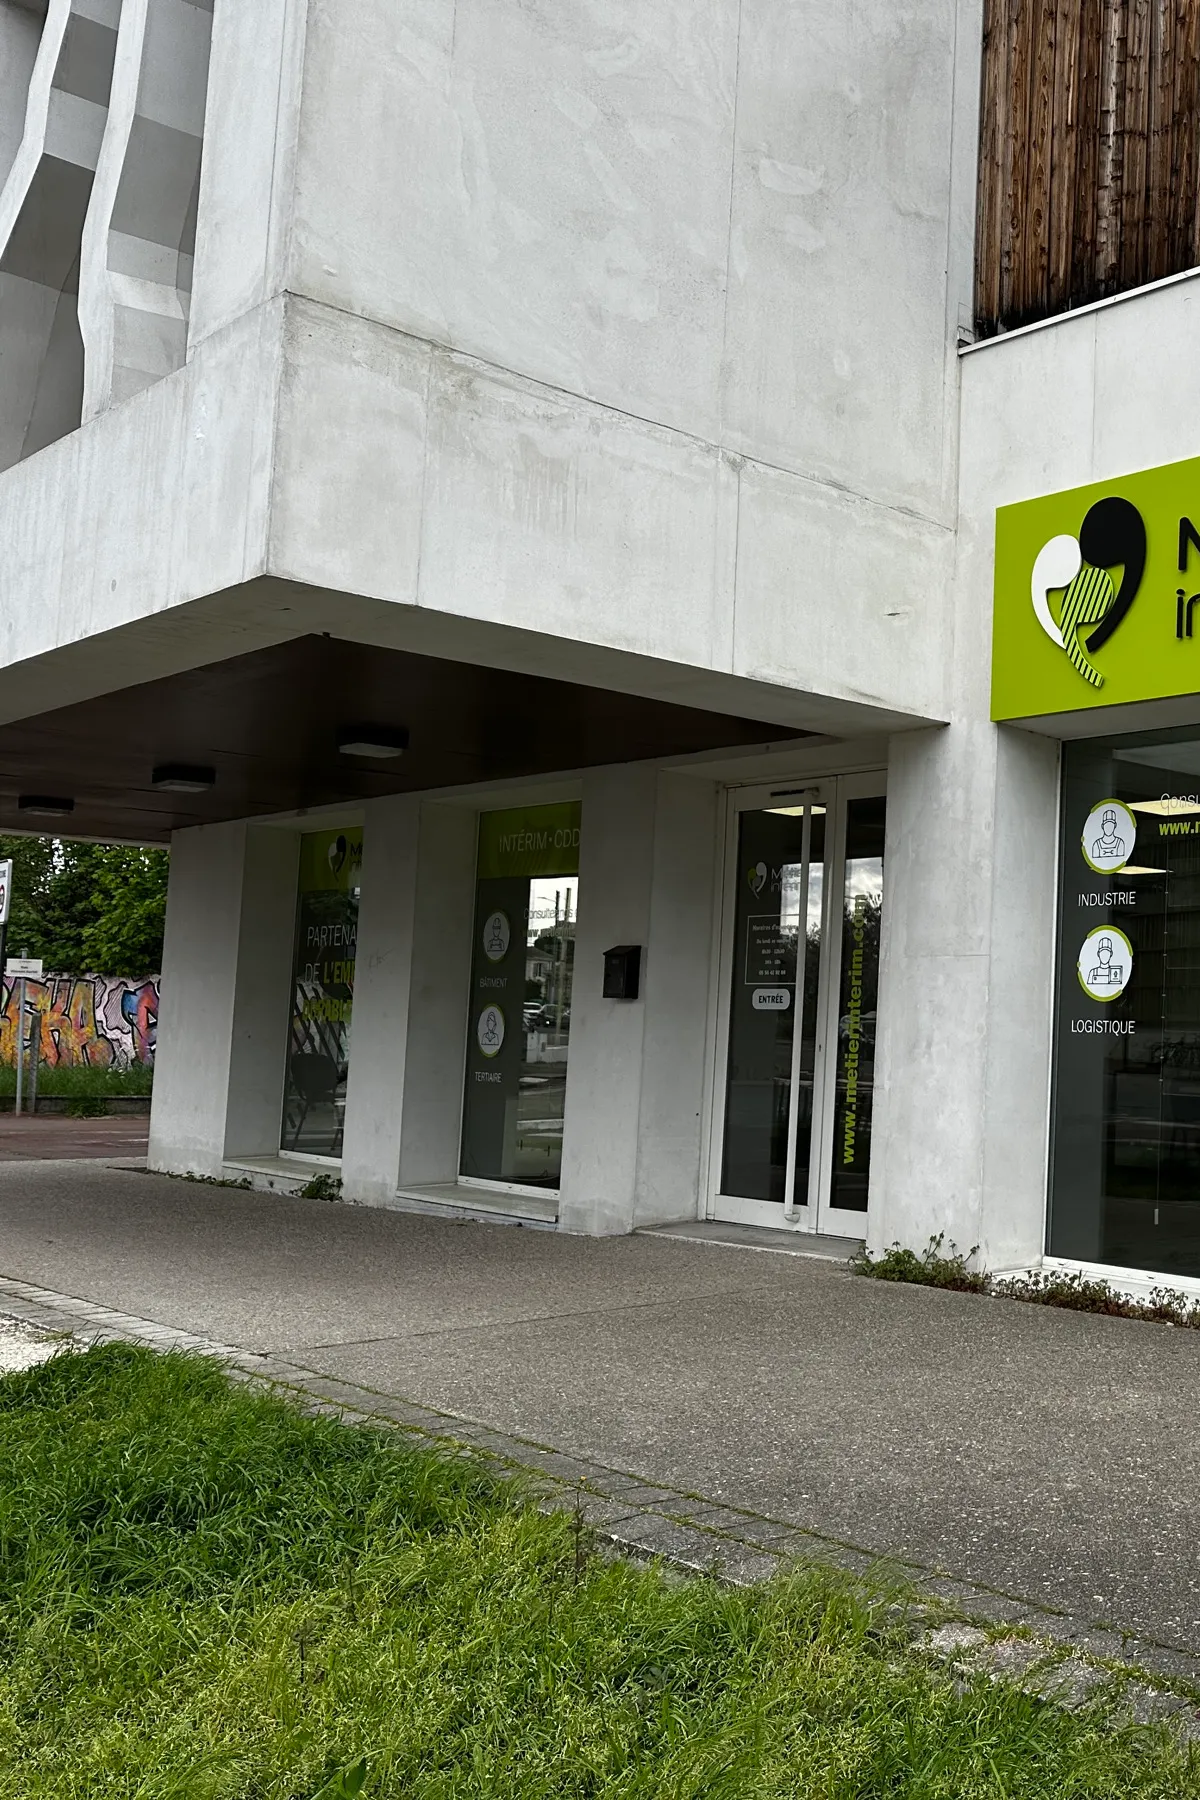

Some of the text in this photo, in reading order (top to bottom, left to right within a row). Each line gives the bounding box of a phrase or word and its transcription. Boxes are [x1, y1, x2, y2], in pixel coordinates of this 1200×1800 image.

[499, 828, 581, 853] INTÉRIM CDD
[1077, 891, 1137, 907] INDUSTRIE
[305, 963, 321, 984] DE
[758, 993, 784, 1004] ENTRÉE
[843, 894, 867, 1165] www.metierinterim.com
[1071, 1019, 1136, 1036] LOGISTIQUE
[475, 1071, 503, 1083] TERTIAIRE
